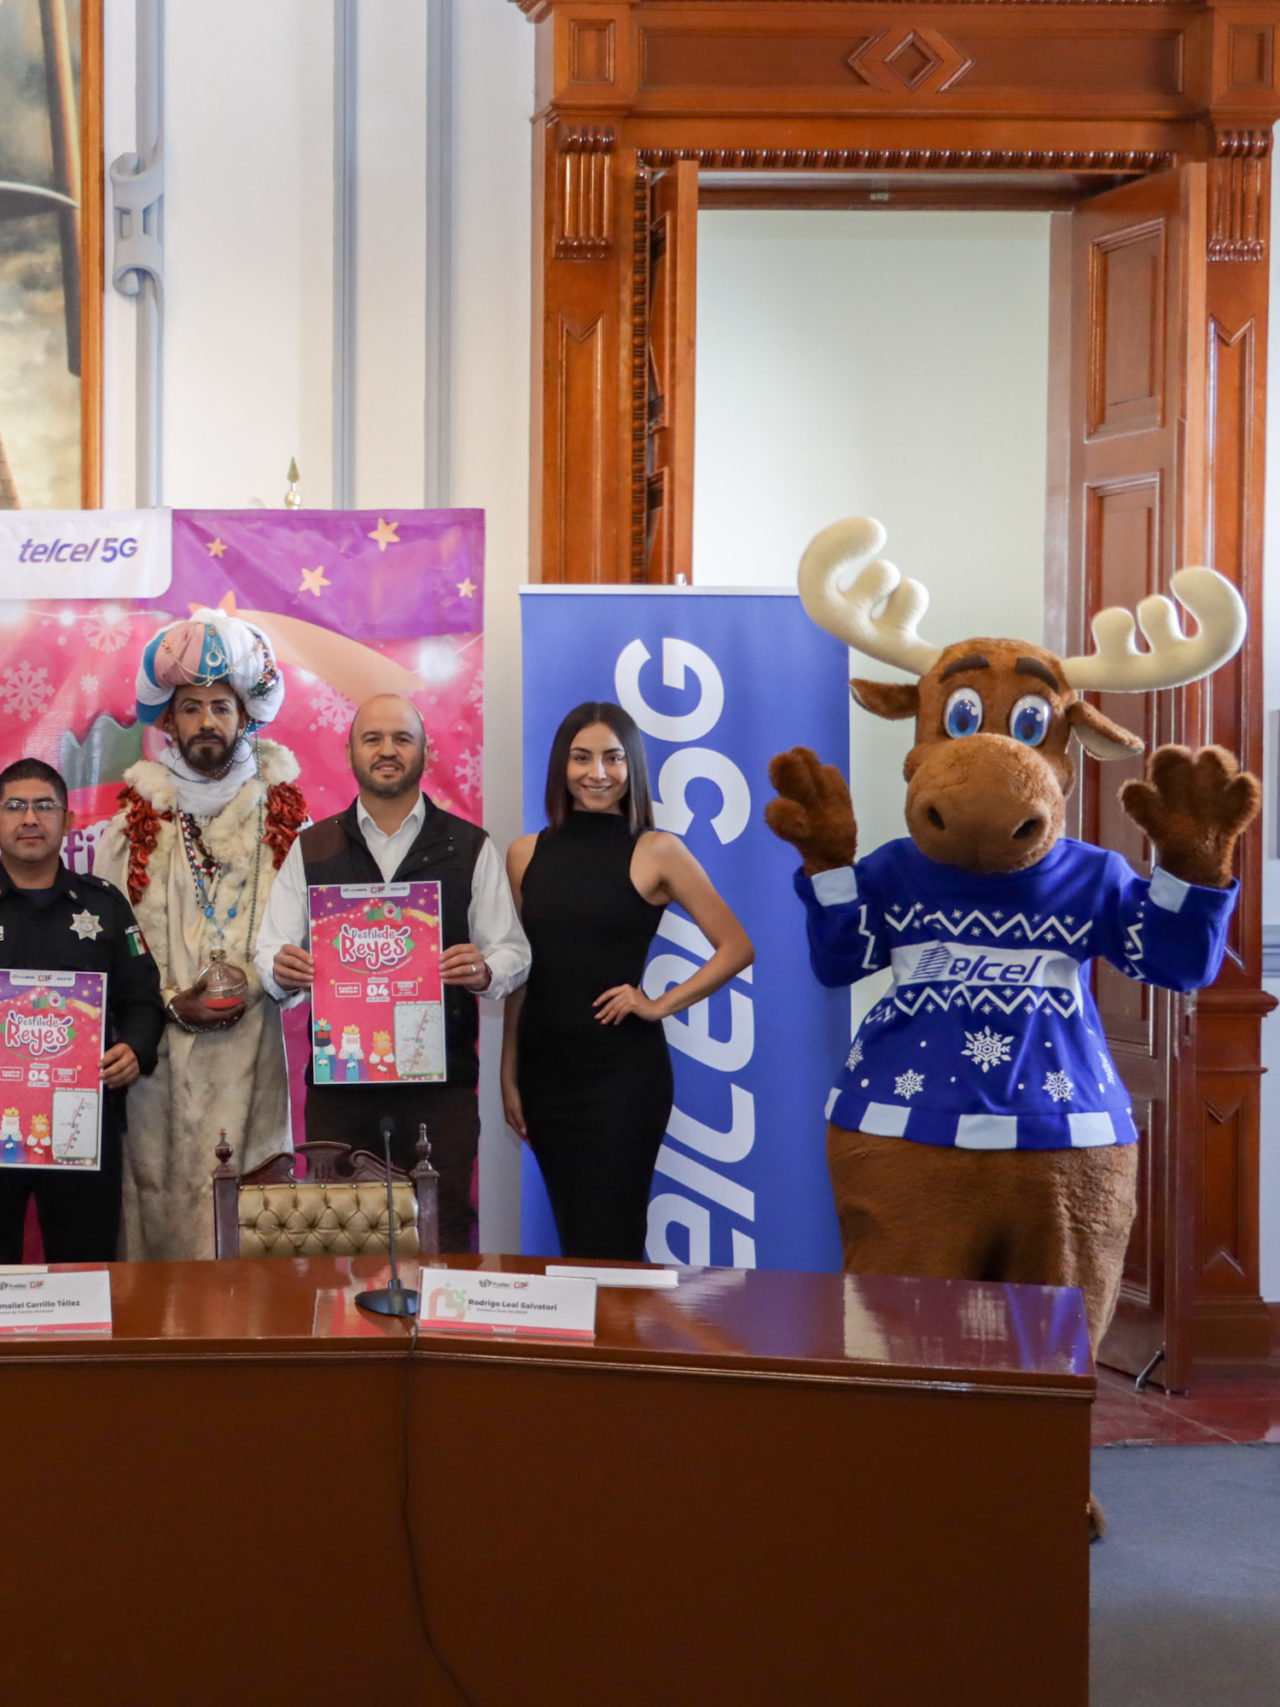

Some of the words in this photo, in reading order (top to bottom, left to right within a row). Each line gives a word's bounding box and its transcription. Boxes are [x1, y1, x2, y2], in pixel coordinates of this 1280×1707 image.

[18, 538, 101, 563] telcel
[101, 537, 139, 563] 5G
[341, 933, 405, 967] Reyes
[367, 984, 389, 997] 04
[7, 1019, 68, 1054] Reyes
[28, 1069, 49, 1082] 04
[26, 1300, 56, 1309] Carrillo
[468, 1298, 501, 1308] Rodrigo
[502, 1300, 519, 1308] Leal
[520, 1302, 558, 1311] Salvatori
